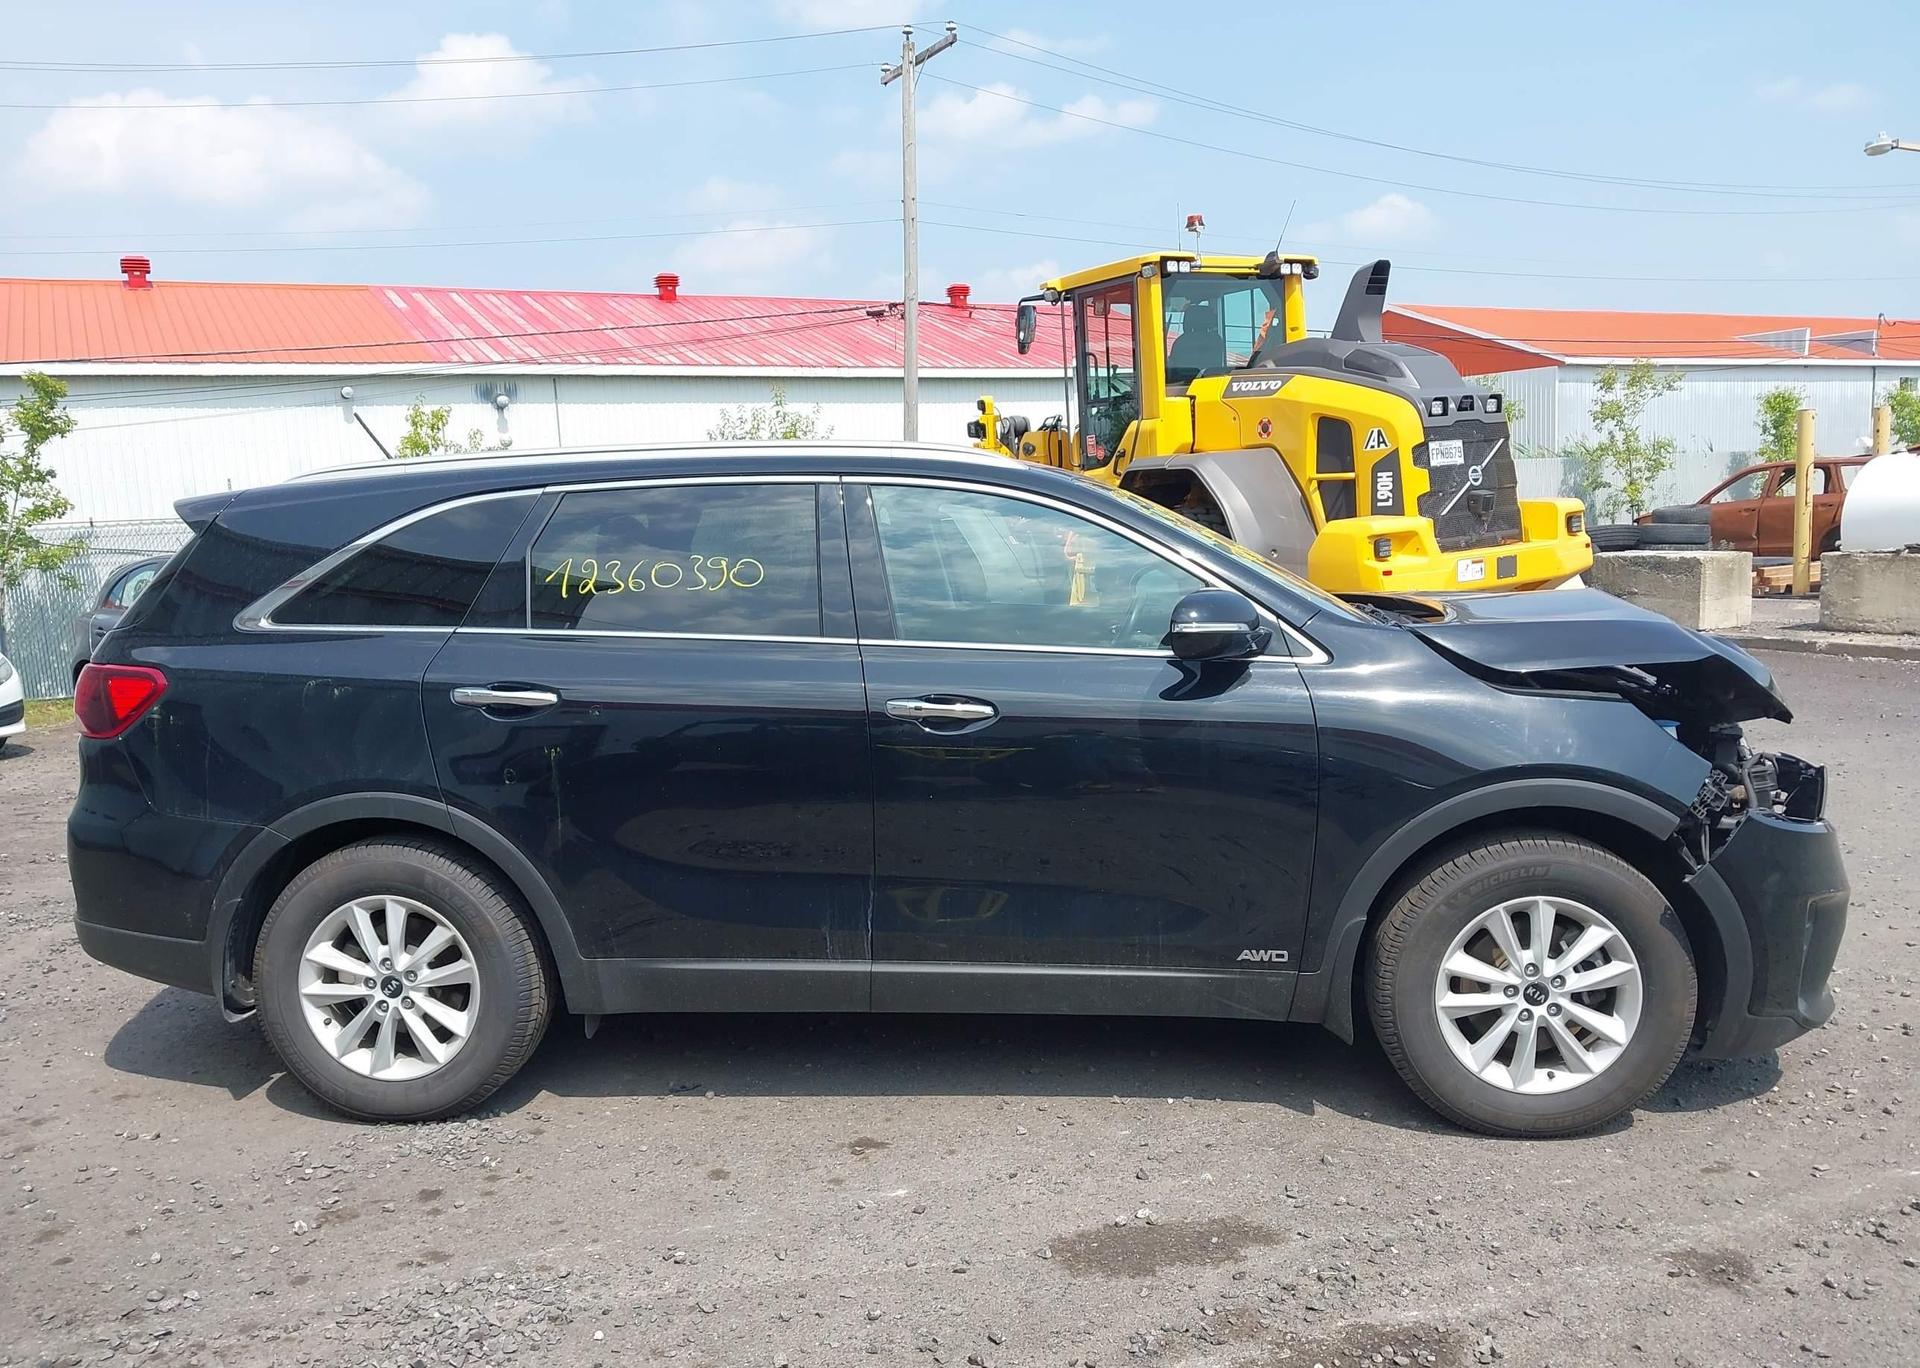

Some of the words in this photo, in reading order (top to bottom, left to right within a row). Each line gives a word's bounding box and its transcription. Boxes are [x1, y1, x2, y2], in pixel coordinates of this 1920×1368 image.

[1231, 380, 1282, 392] VOLVO
[1376, 471, 1394, 507] L90H
[545, 554, 764, 599] 12360390
[1236, 949, 1289, 962] AWD
[383, 980, 400, 996] KIA
[1526, 986, 1545, 1003] KIA
